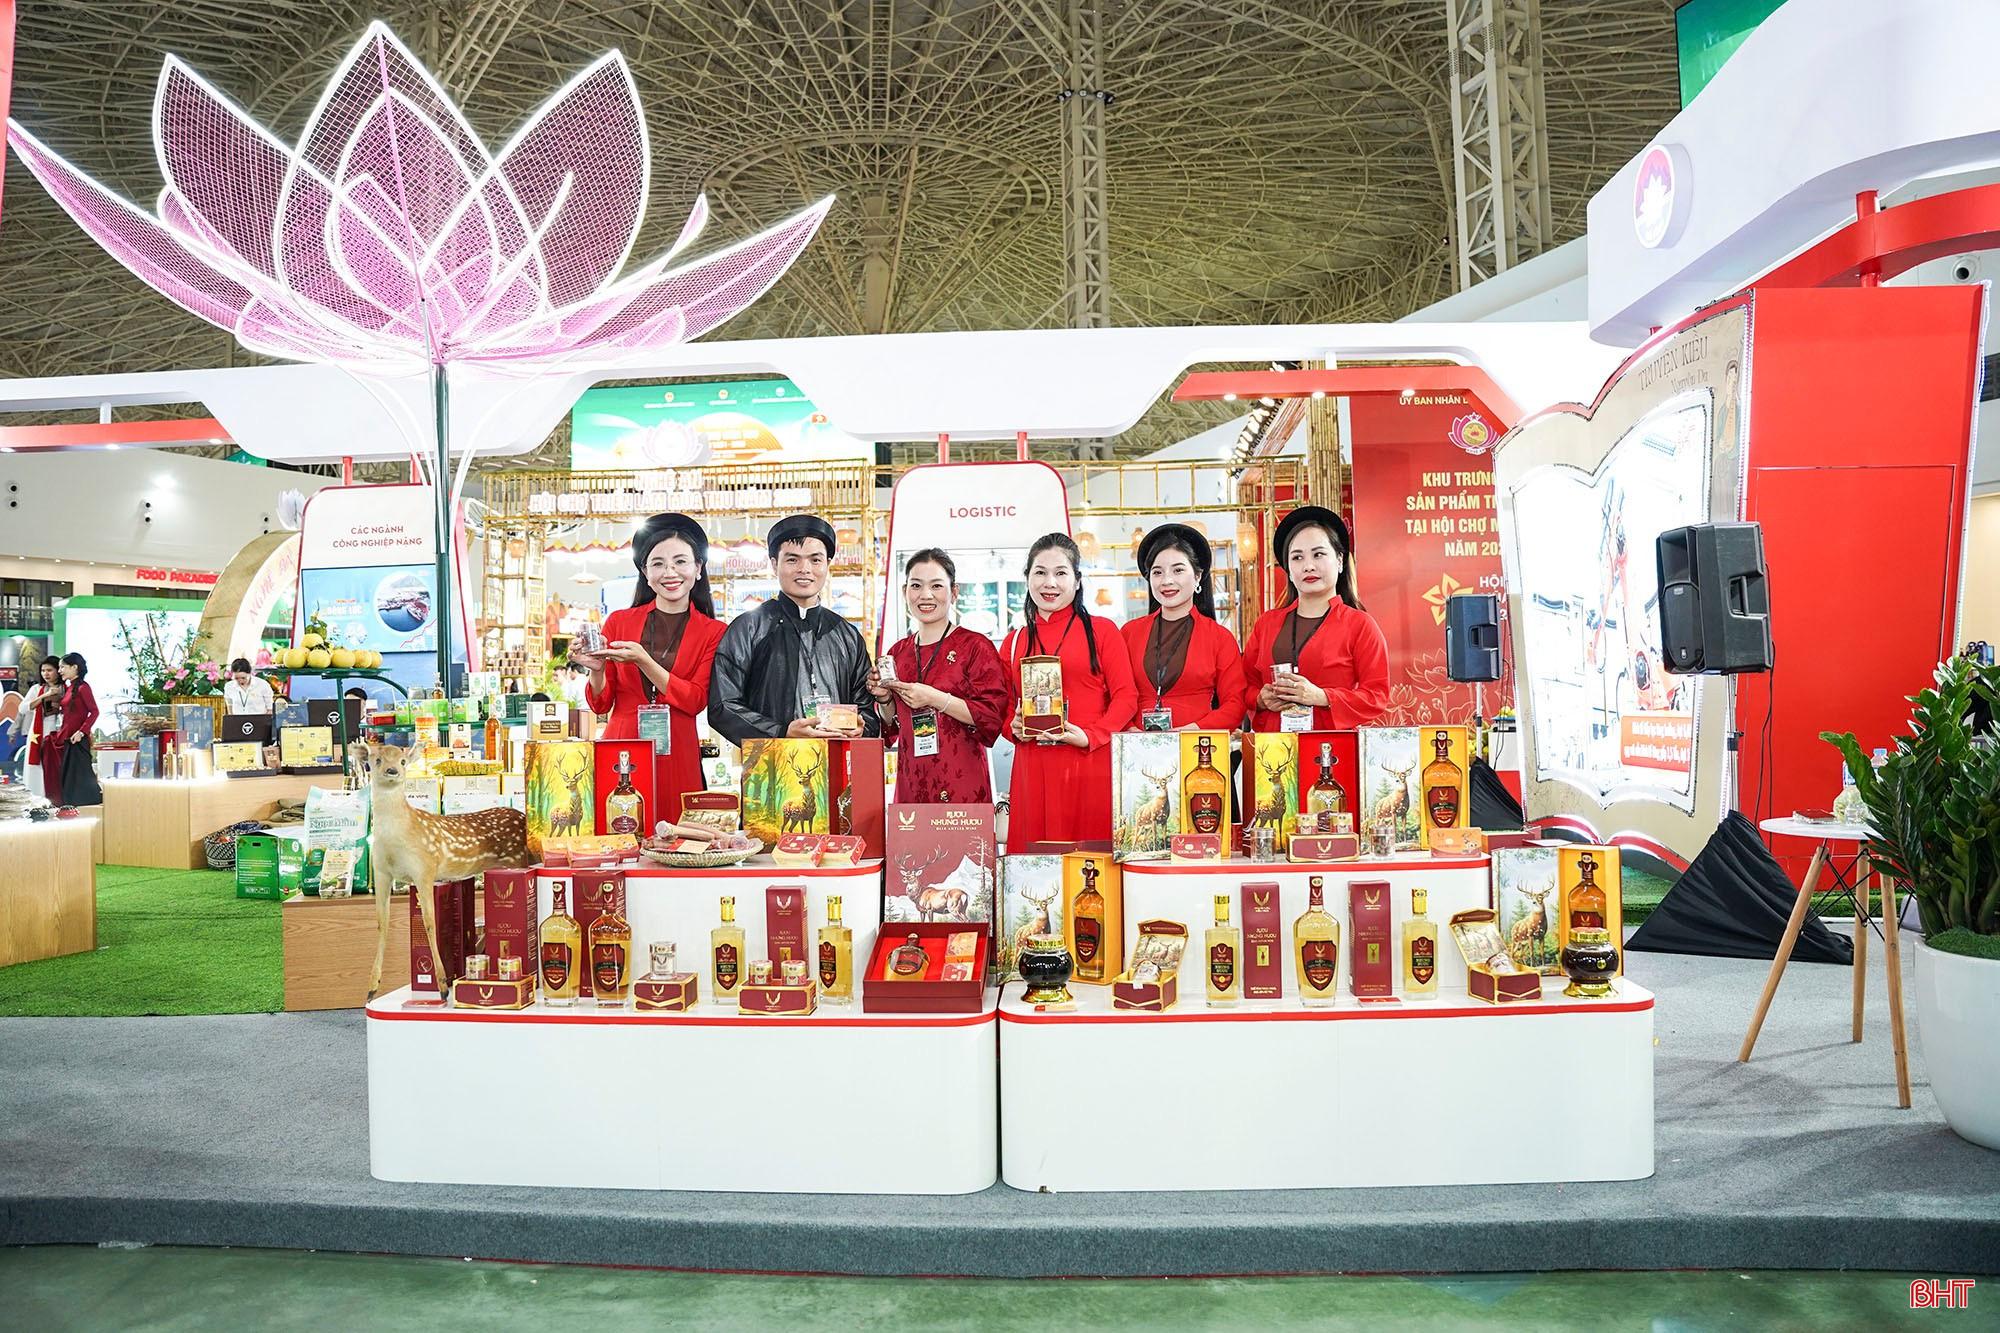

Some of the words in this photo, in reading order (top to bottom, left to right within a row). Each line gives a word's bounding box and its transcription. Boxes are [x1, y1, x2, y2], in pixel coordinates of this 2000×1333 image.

[1682, 330, 1708, 366] KIỀU
[1414, 397, 1433, 405] BAN
[1435, 394, 1461, 405] NHÂN
[1422, 472, 1451, 487] KHU
[1406, 491, 1436, 511] SẢN
[1439, 489, 1480, 510] PHẨM
[949, 506, 1017, 519] LOGISTIC
[350, 524, 370, 535] CÁC
[1405, 519, 1428, 537] TẠI
[1431, 515, 1455, 537] HỘI
[1458, 516, 1488, 536] CHỢ
[360, 537, 395, 549] NGHIỆP
[1444, 539, 1478, 557] NĂM
[135, 567, 167, 581] FOOD
[170, 570, 219, 585] PARADIS
[1479, 574, 1504, 590] HỘI
